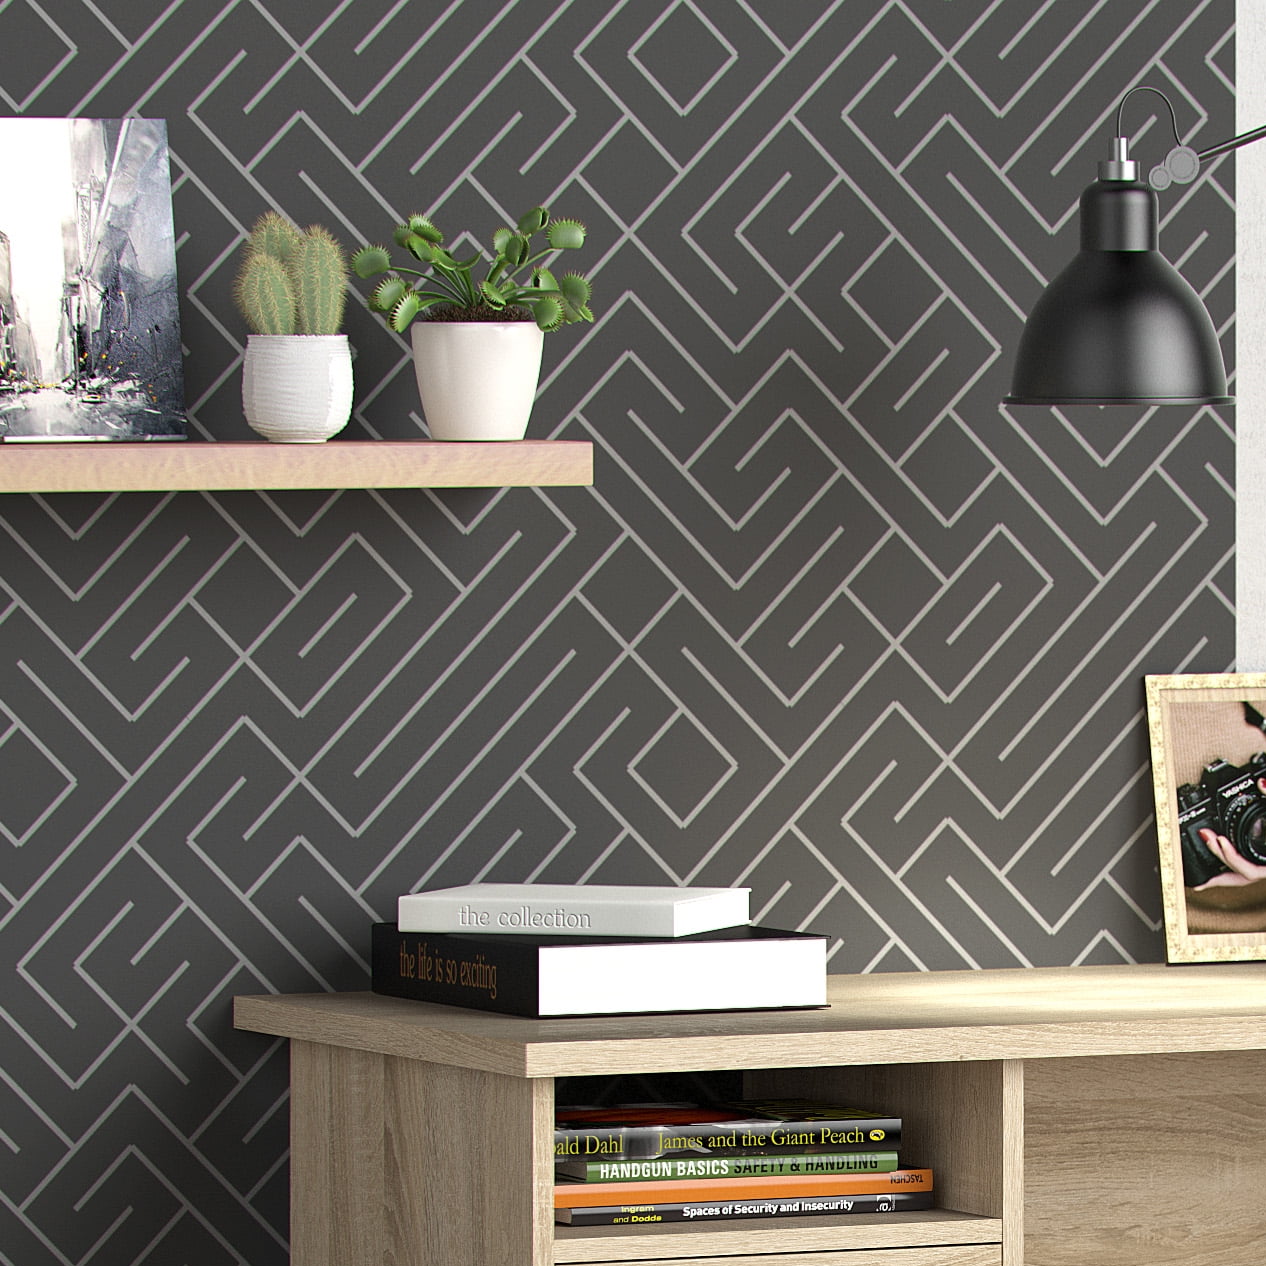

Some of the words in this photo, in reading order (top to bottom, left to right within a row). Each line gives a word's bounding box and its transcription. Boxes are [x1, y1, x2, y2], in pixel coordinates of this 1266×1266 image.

[1221, 779, 1254, 799] YASHICA
[458, 905, 490, 928] the
[497, 905, 592, 930] collection
[399, 940, 416, 980] the
[418, 943, 433, 982] life
[436, 949, 444, 984] is
[446, 958, 457, 986] so
[460, 954, 498, 1000] exciting
[585, 1134, 624, 1154] Dahl
[656, 1132, 703, 1154] James
[708, 1130, 737, 1147] and
[742, 1129, 766, 1146] the
[771, 1128, 816, 1146] Giant
[820, 1126, 865, 1144] Peach
[600, 1162, 672, 1179] HANDGUN
[677, 1159, 729, 1176] BASICS
[734, 1157, 784, 1174] SAFETY
[790, 1156, 801, 1171] &
[805, 1153, 878, 1171] HANDLING
[890, 1174, 924, 1184] TASCHEN
[621, 1205, 655, 1214] Ingram
[683, 1206, 720, 1218] Spaces
[722, 1203, 733, 1215] of
[734, 1202, 778, 1216] Security
[780, 1202, 799, 1213] and
[801, 1200, 853, 1213] Insecurity
